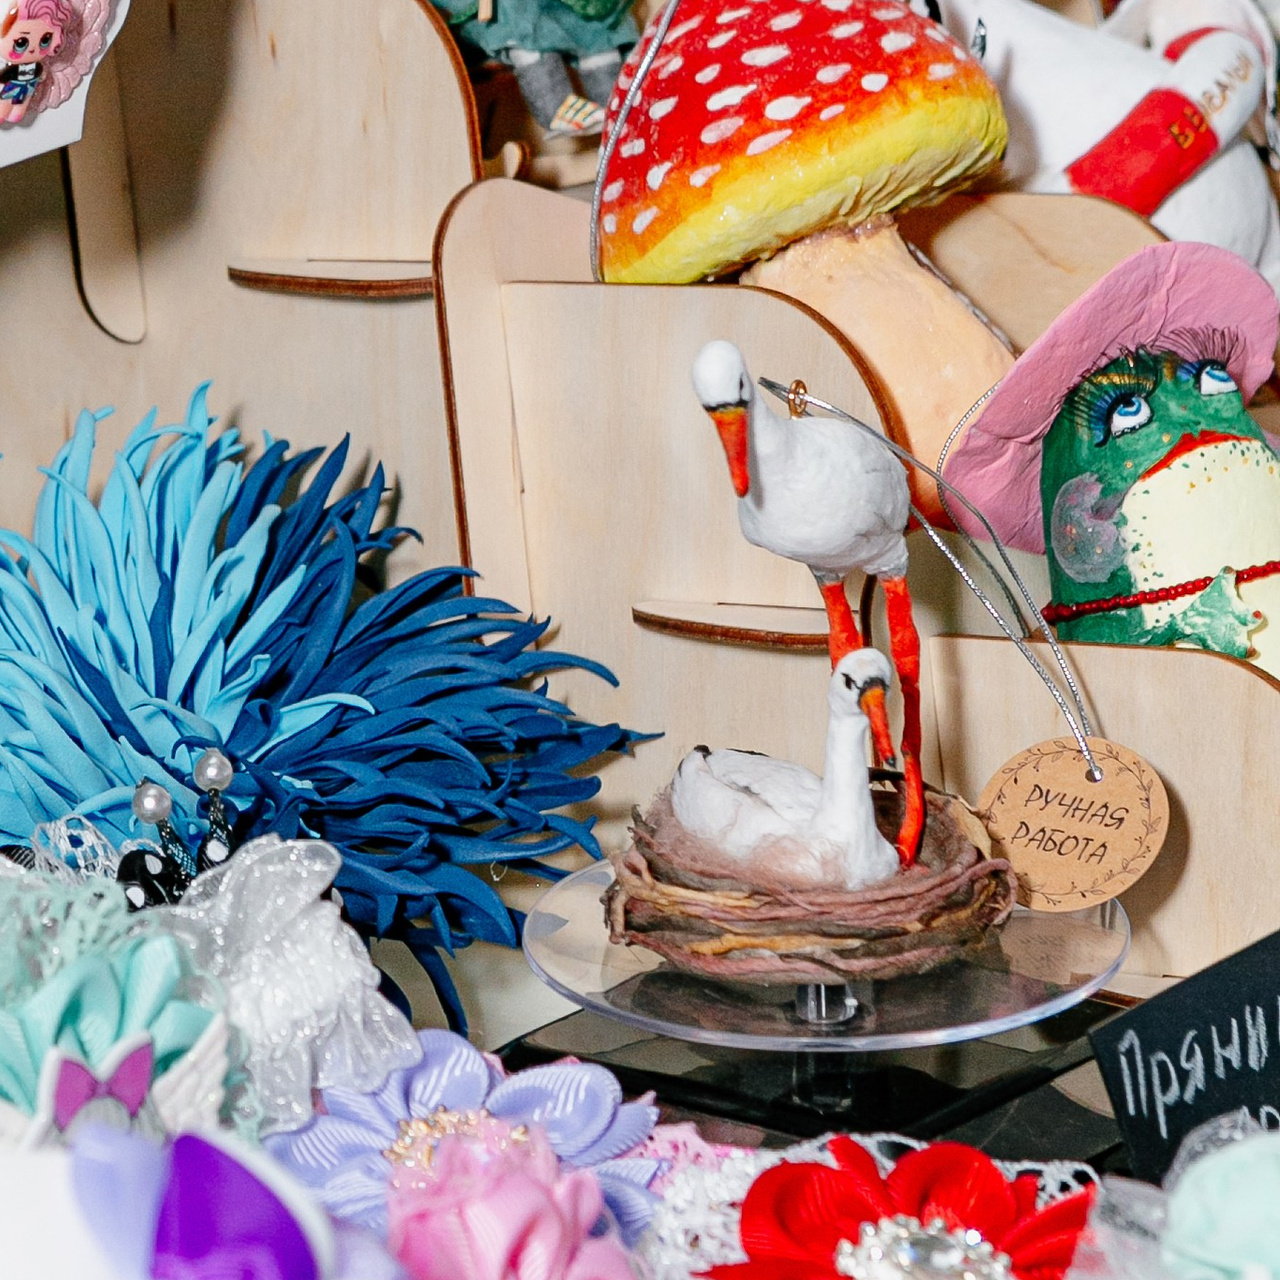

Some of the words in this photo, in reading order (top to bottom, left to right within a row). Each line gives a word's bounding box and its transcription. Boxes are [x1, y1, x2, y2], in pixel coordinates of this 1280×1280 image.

[1024, 784, 1130, 830] РУЧНАЯ
[1011, 821, 1108, 865] РАБОТА
[1118, 994, 1280, 1140] Пряни
